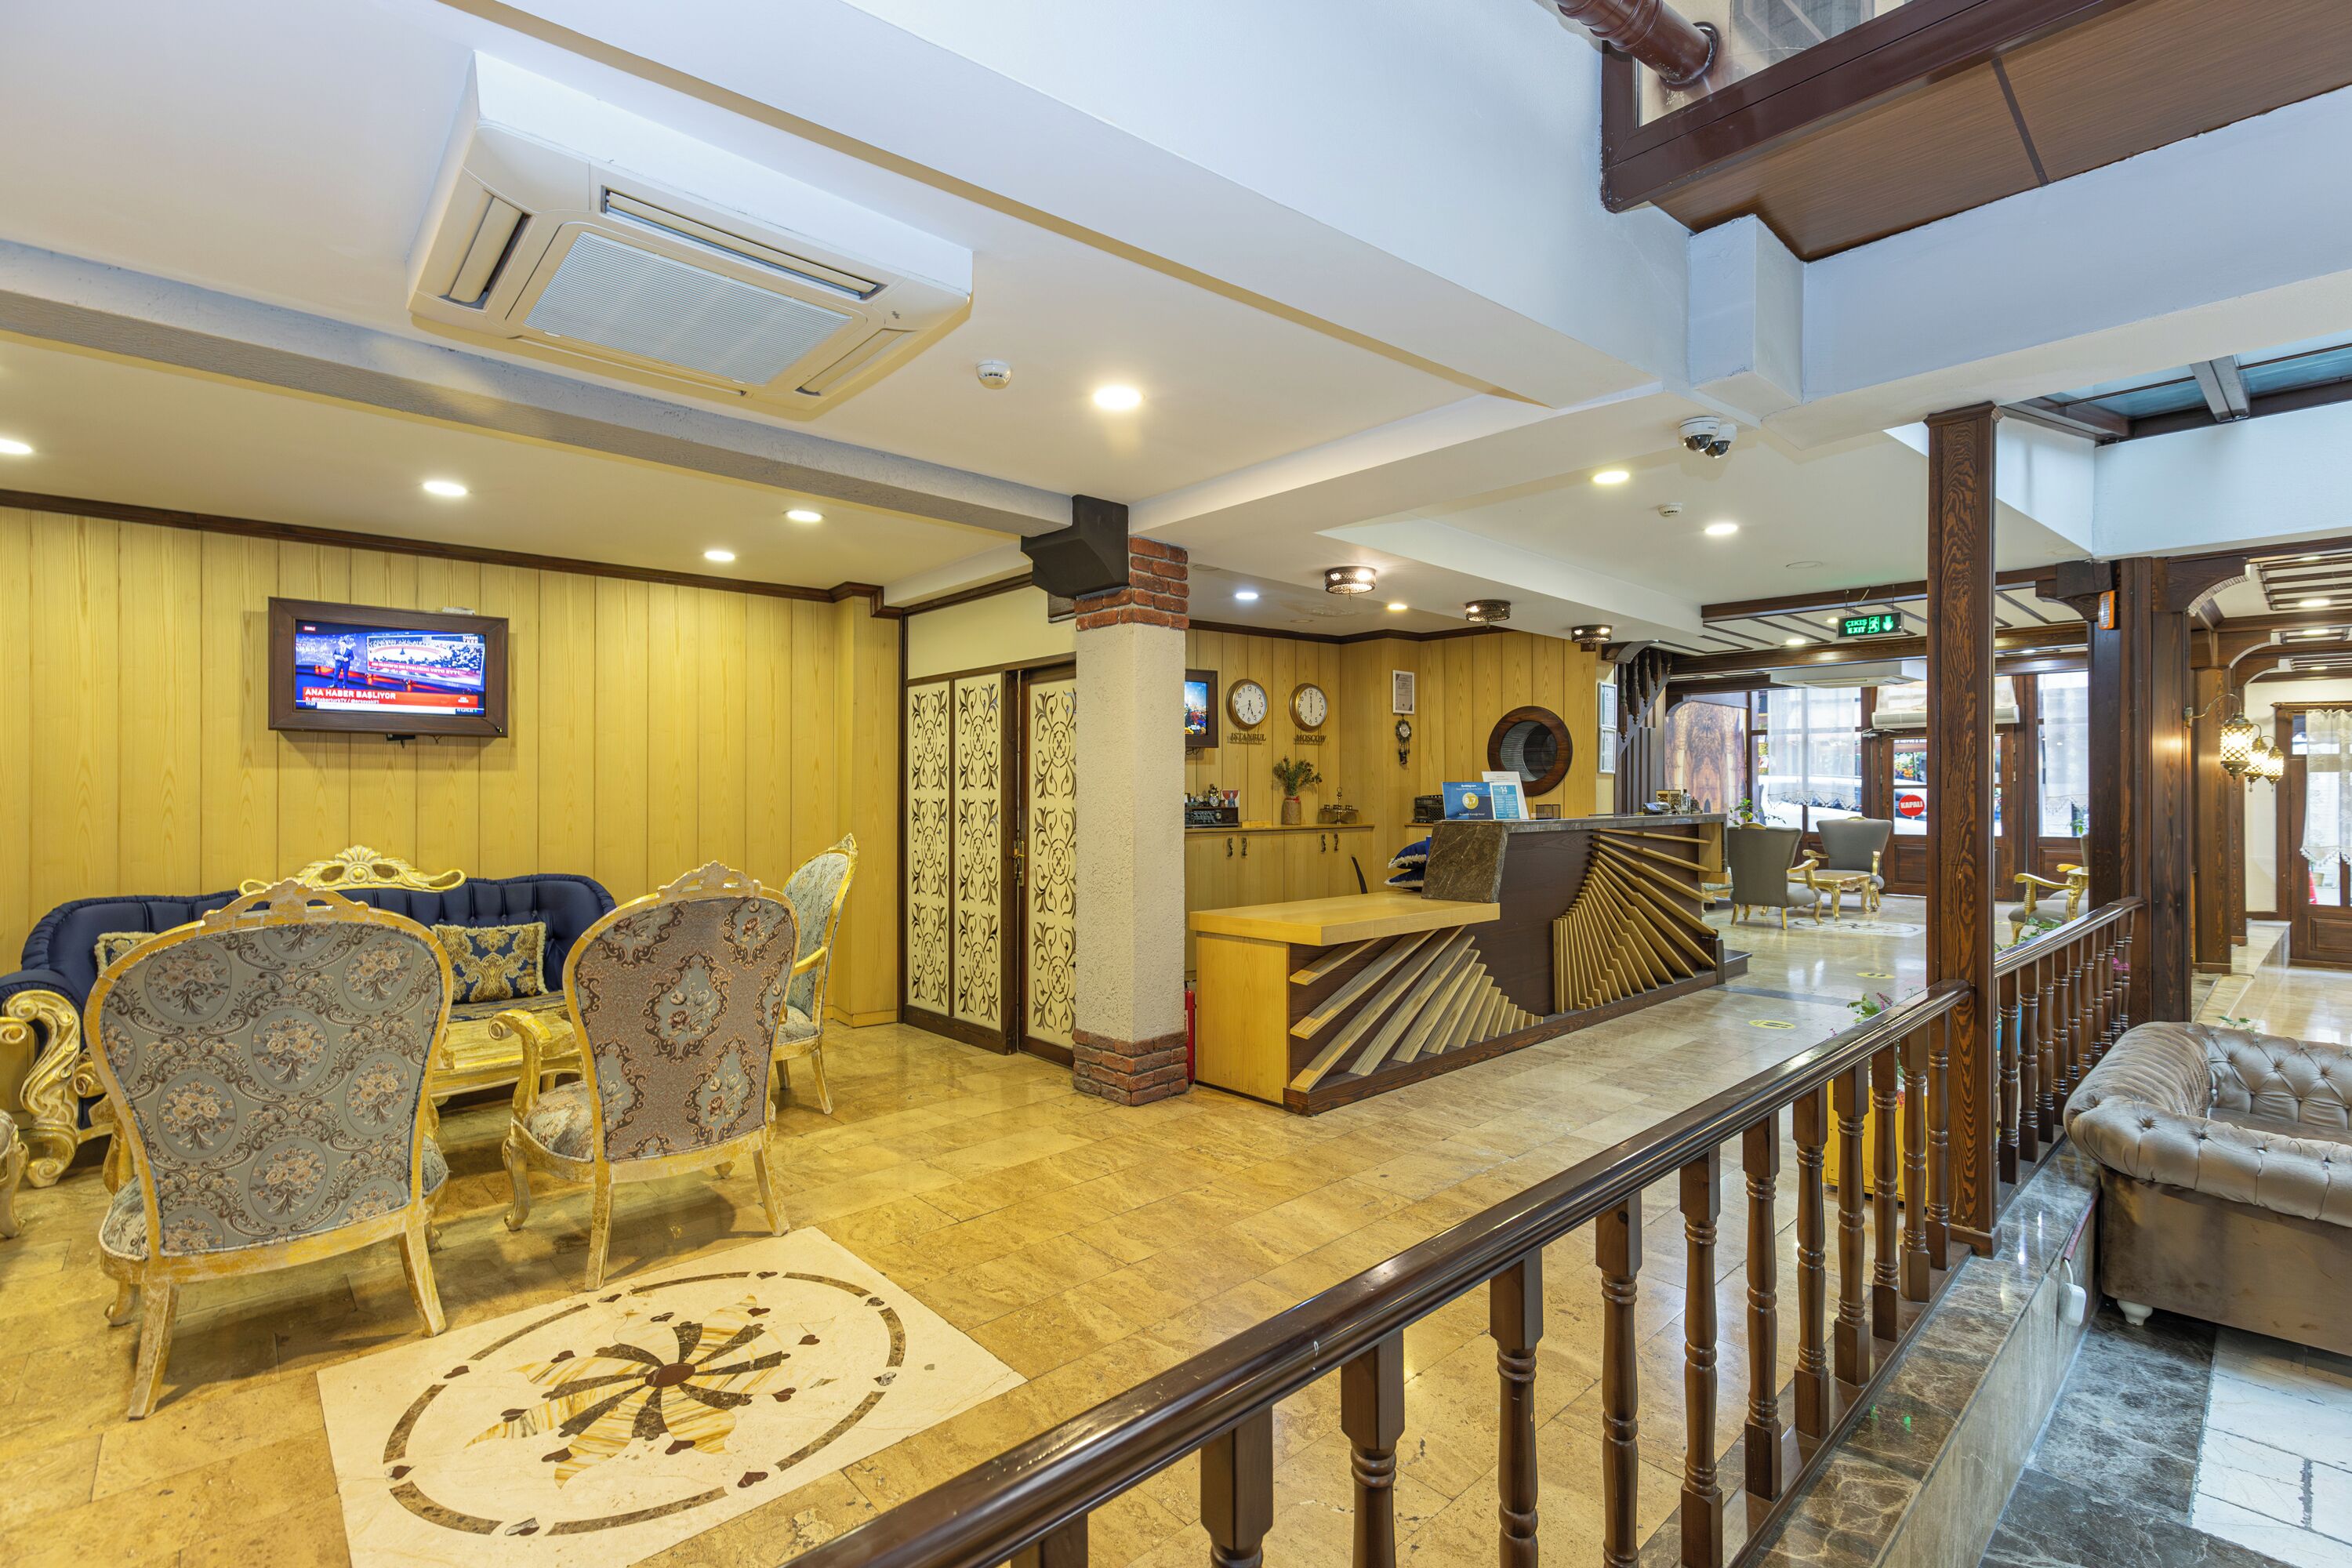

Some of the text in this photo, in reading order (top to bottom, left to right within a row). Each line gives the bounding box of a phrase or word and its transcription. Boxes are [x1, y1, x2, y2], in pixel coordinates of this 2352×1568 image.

[325, 689, 354, 698] HABER
[356, 691, 396, 699] BAŞLIYOR
[1230, 732, 1266, 742] ISTANBUL
[1296, 734, 1327, 742] MOSCOW
[1900, 800, 1923, 809] KAPALI
